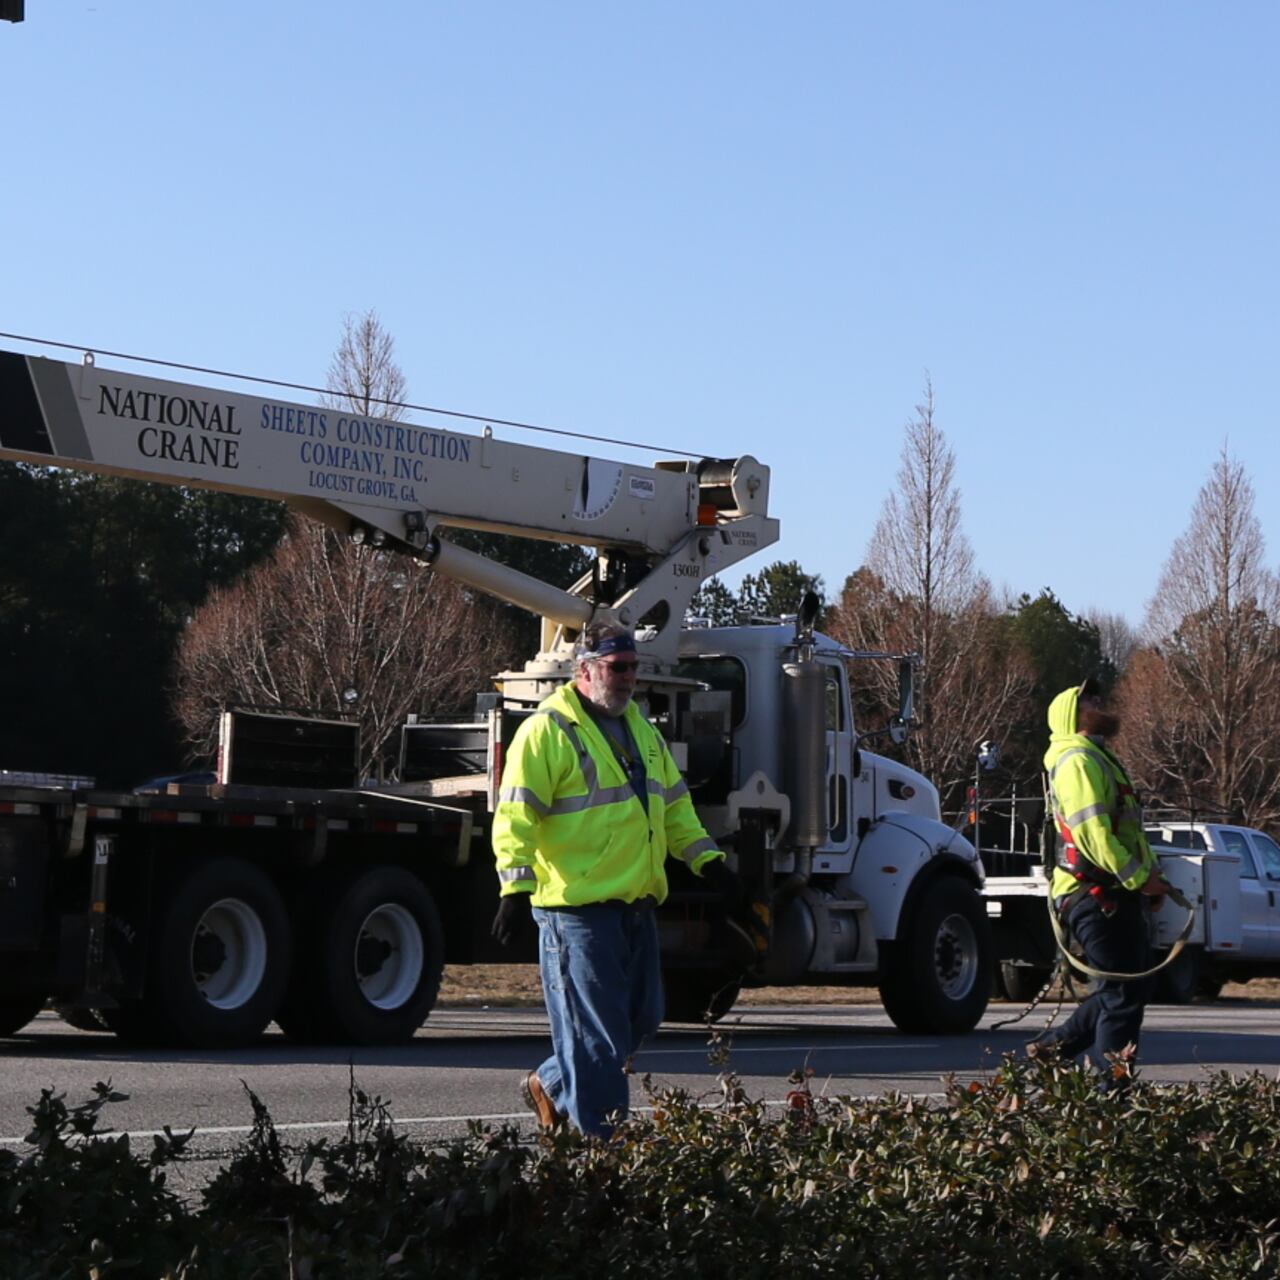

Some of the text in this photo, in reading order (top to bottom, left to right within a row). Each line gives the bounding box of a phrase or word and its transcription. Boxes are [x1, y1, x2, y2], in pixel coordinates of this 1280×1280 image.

[97, 384, 242, 436] NATIONAL
[137, 427, 240, 469] CRANE
[260, 403, 471, 463] SHEETS CONSTRUCTION
[300, 440, 428, 483] COMPANY, INC.
[309, 470, 355, 493] LOCUST
